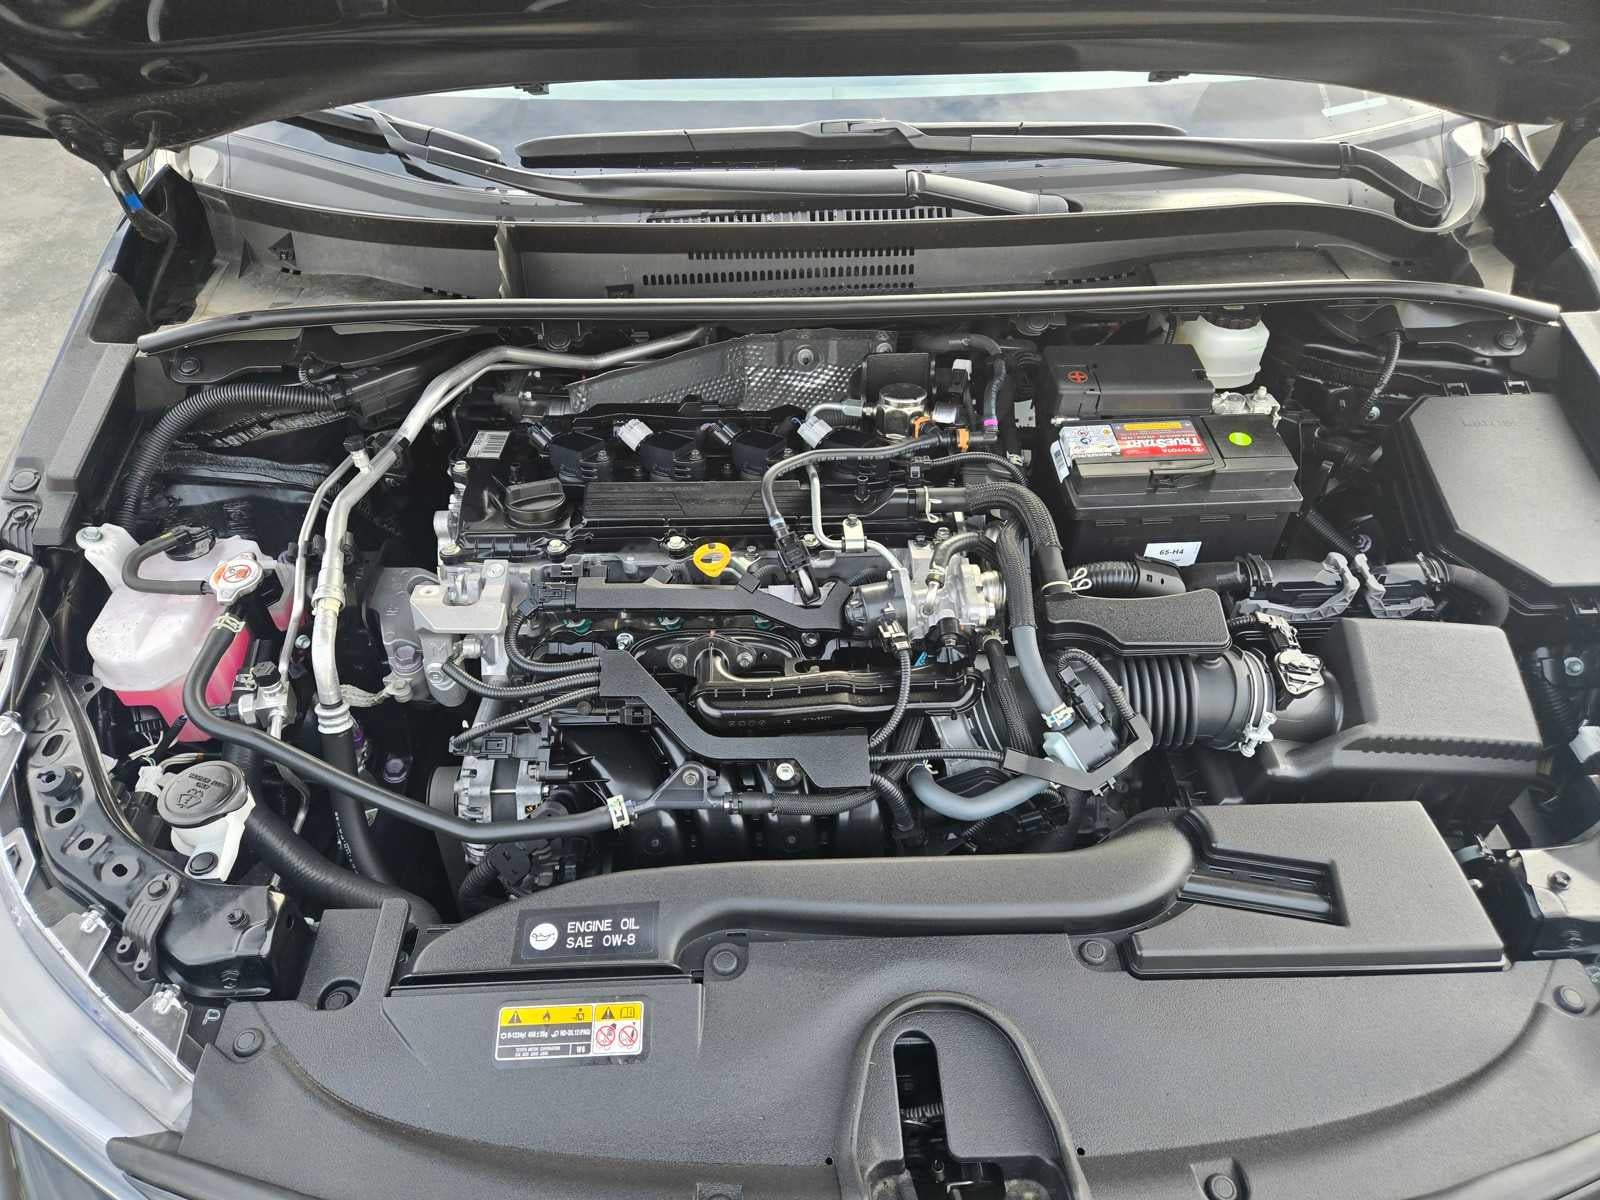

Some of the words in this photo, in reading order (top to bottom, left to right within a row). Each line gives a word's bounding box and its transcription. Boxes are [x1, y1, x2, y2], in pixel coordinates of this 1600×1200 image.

[1159, 548, 1184, 556] 65-H4
[567, 919, 613, 933] ENGINE
[620, 917, 640, 930] OIL
[565, 935, 594, 948] SAE
[602, 933, 636, 947] 0W-8
